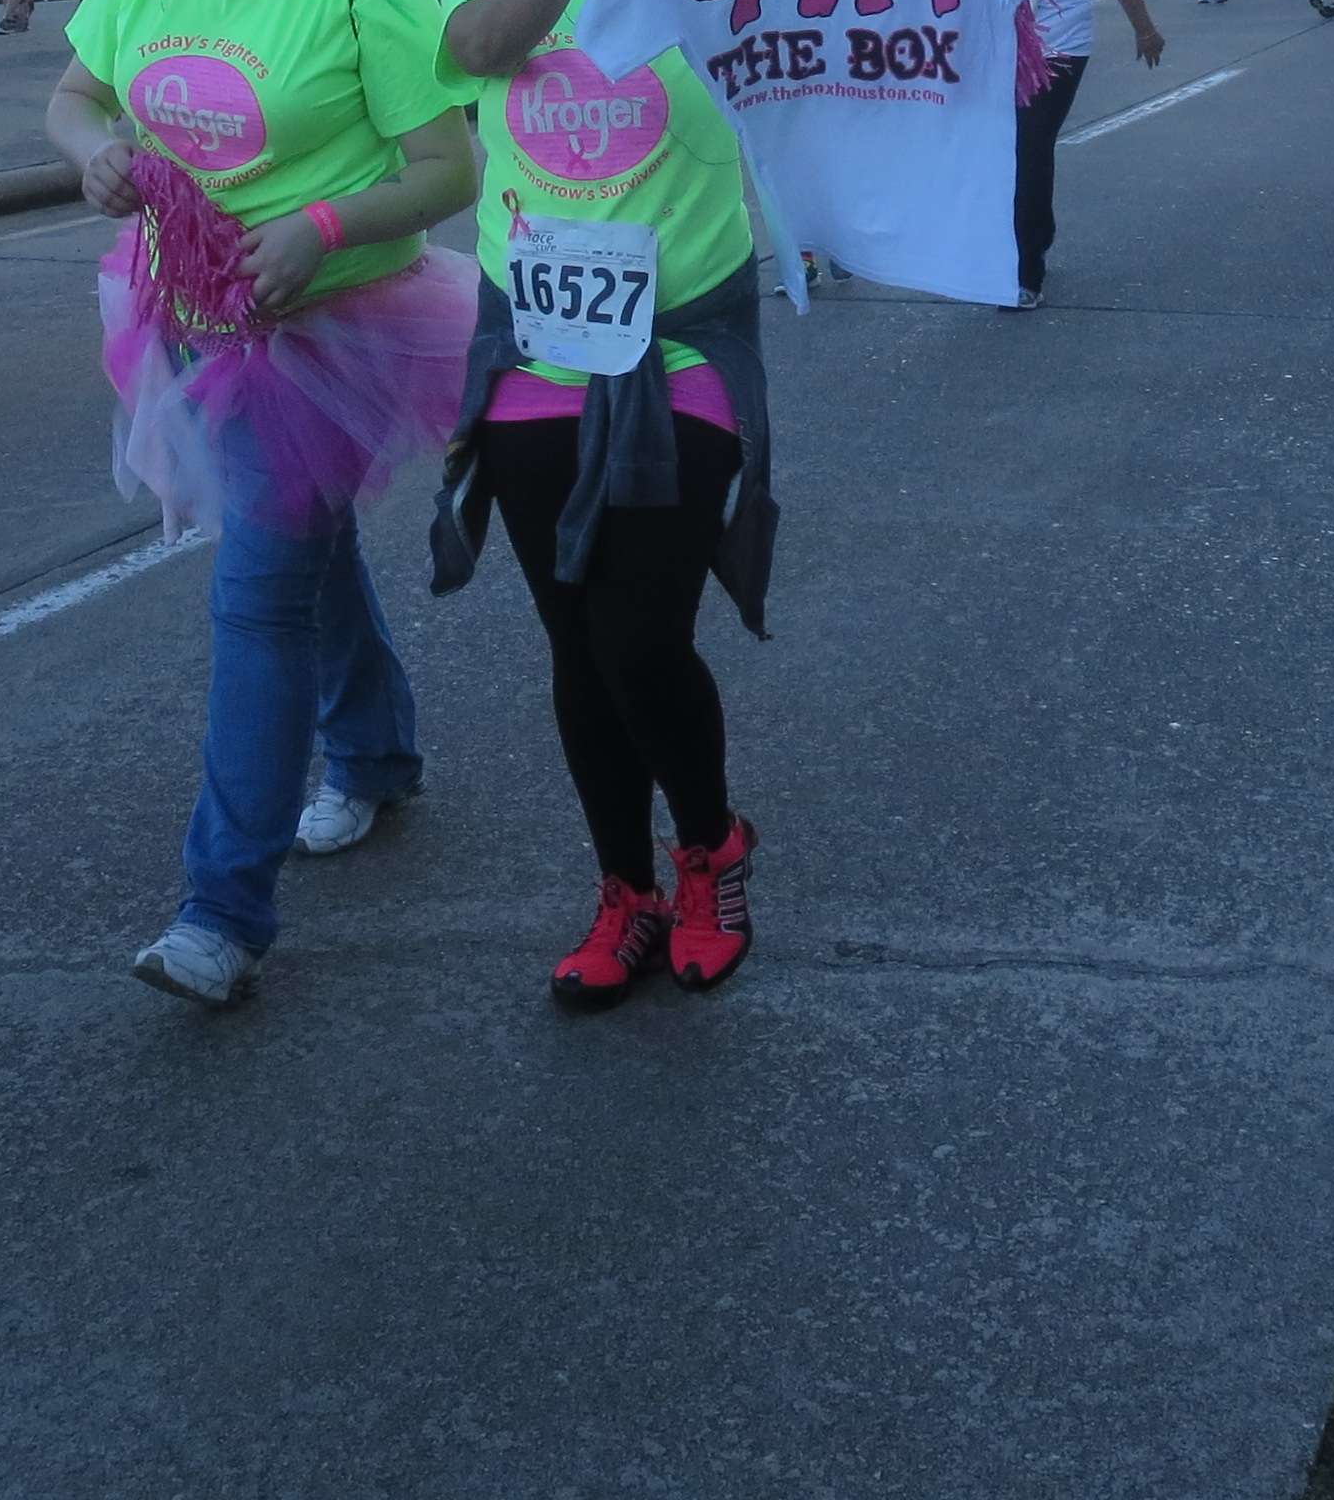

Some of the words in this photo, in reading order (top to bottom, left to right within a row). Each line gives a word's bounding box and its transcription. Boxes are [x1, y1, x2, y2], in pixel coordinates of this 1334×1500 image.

[137, 35, 209, 58] Today's
[213, 38, 269, 80] Fighters
[707, 29, 826, 100] THE
[845, 25, 960, 84] BOX
[145, 75, 246, 151] Kroger
[522, 71, 647, 160] Kroger
[732, 82, 946, 112] www.theboxhouston.com
[205, 160, 273, 189] Survivors
[512, 152, 596, 201] Tomorrow's
[600, 150, 670, 199] Survivors
[510, 259, 649, 326] 16527
